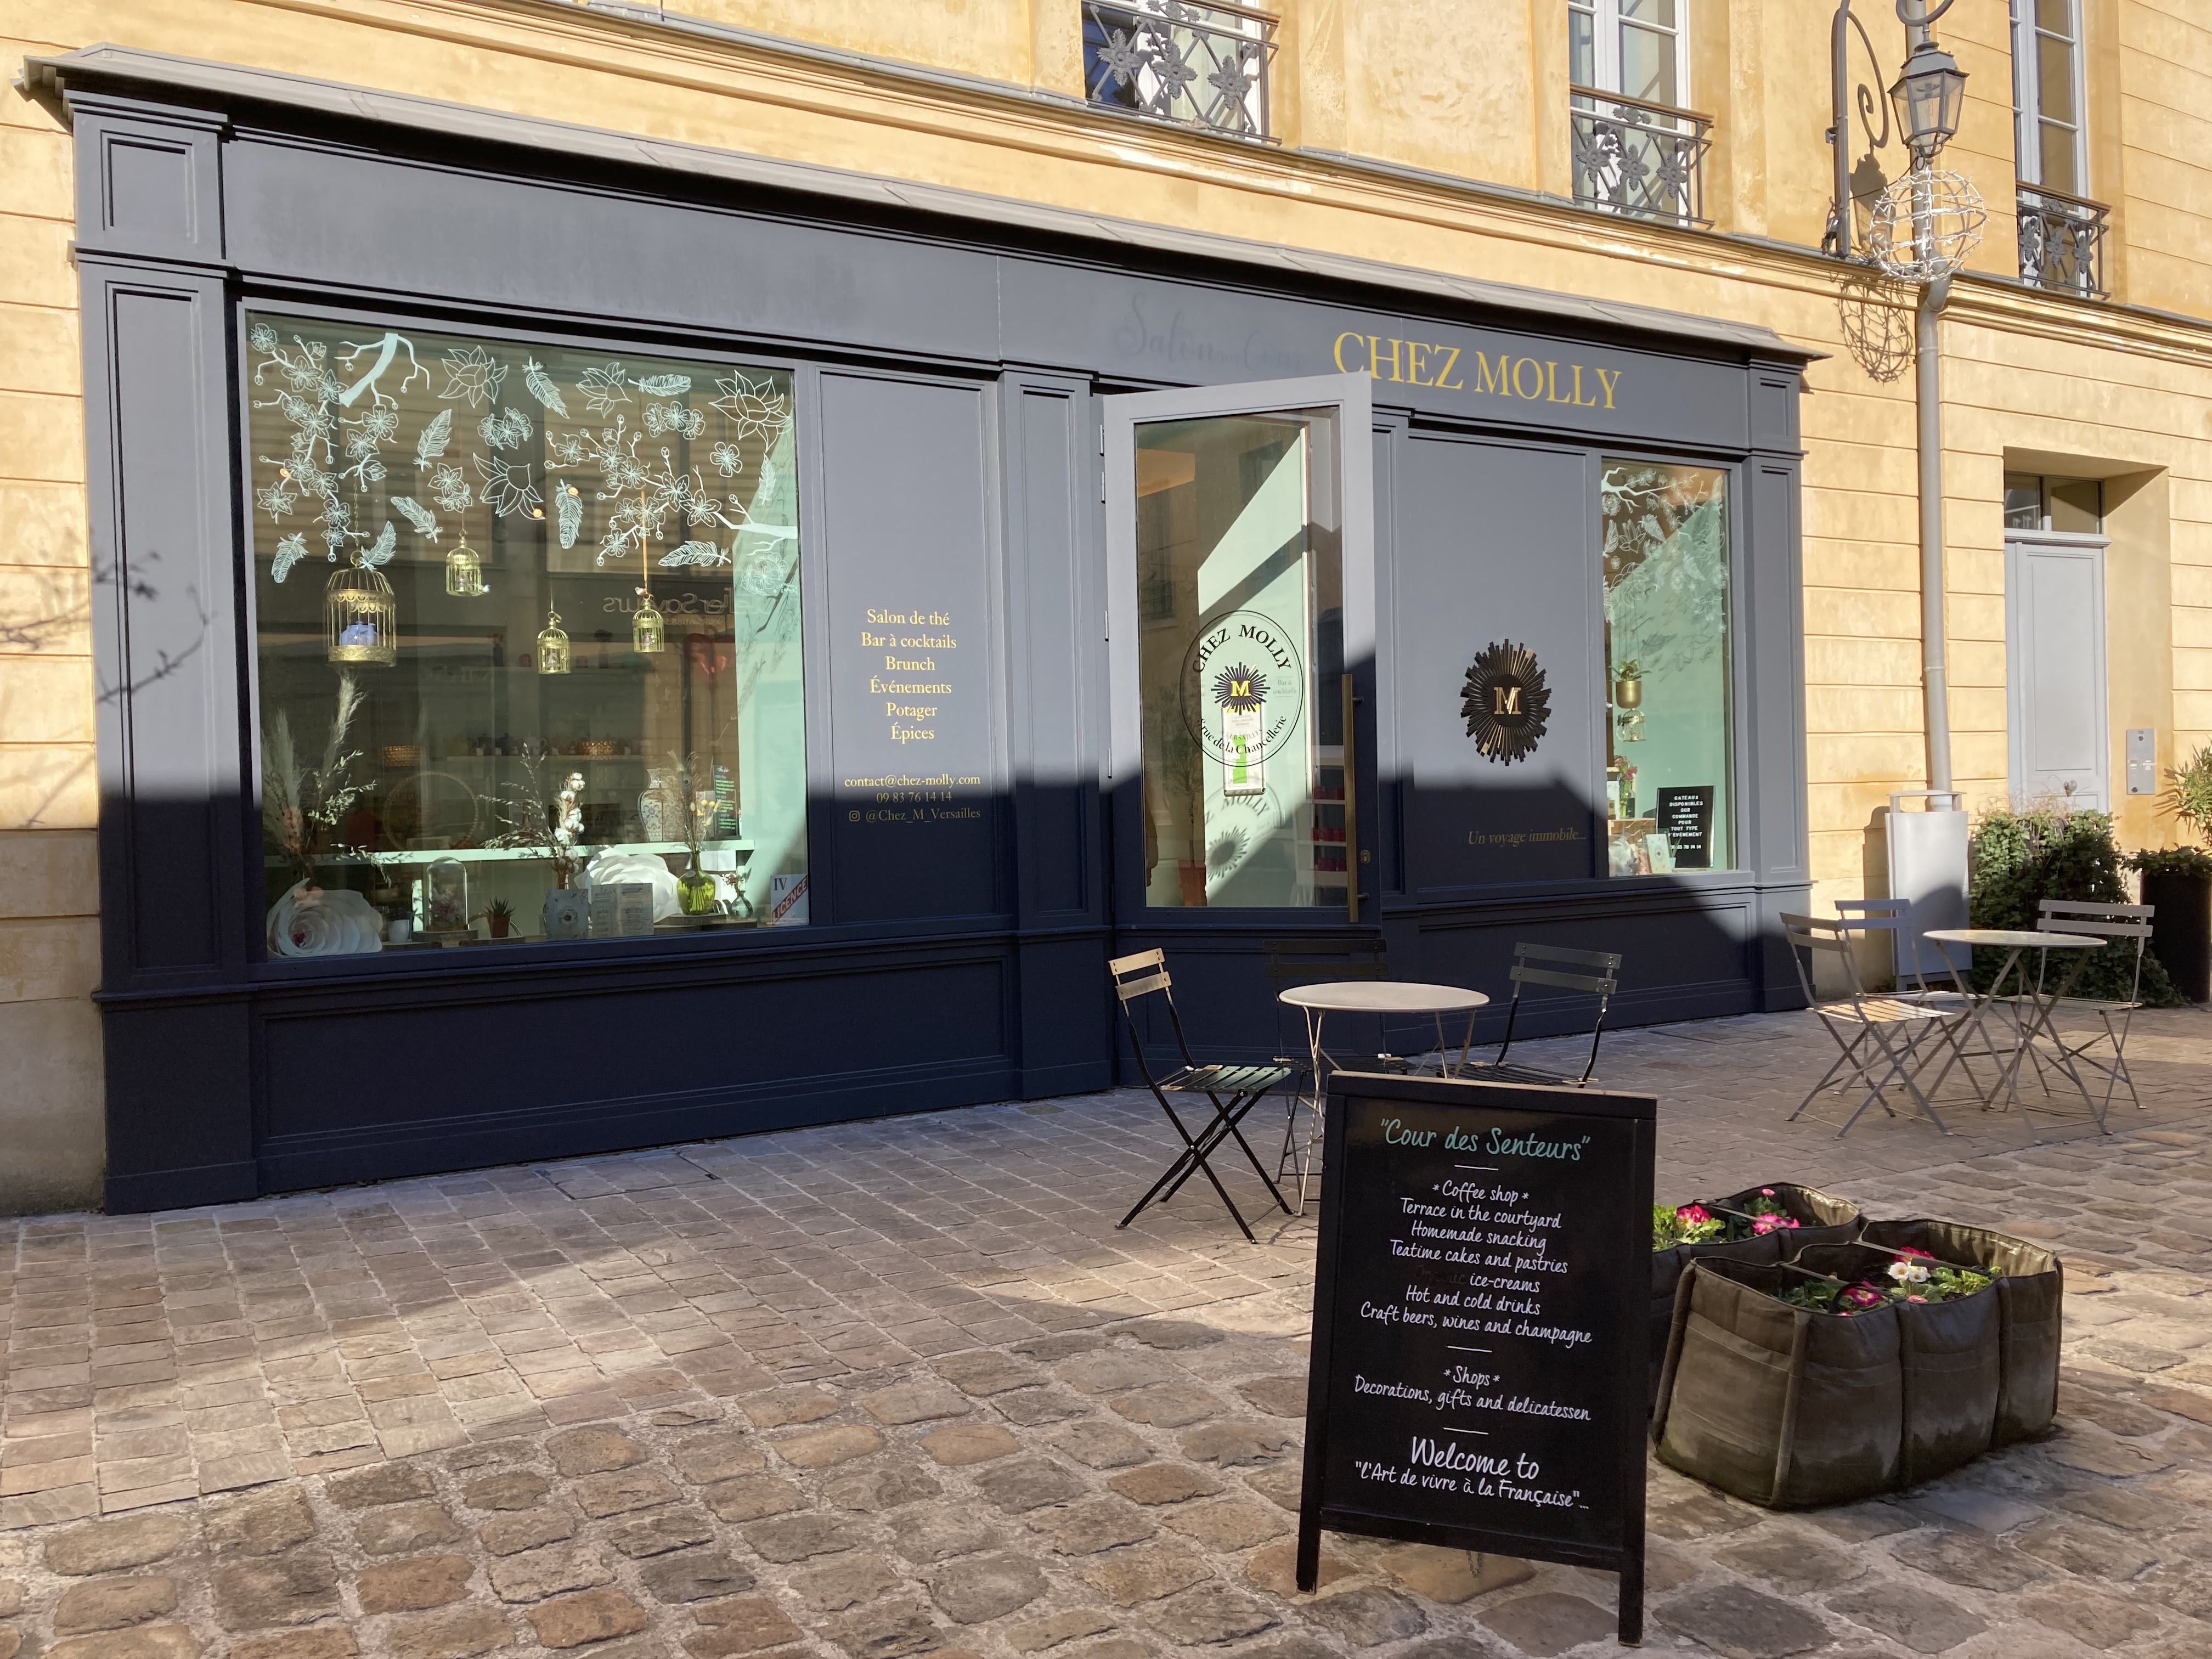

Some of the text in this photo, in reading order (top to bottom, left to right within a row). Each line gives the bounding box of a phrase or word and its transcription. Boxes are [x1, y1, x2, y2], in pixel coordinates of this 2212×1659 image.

[1334, 332, 1622, 409] CHEZ MOLLY
[867, 608, 950, 625] Salon de thé
[861, 631, 957, 648] Bar à cocktails
[1192, 624, 1291, 673] CHEZ MOLLY
[885, 656, 935, 670] Brunch
[870, 675, 952, 693] Événements
[1231, 680, 1251, 697] M
[886, 702, 938, 721] Potager
[1494, 686, 1522, 715] M
[890, 721, 935, 744] Épices
[1201, 725, 1214, 741] rue
[1213, 738, 1224, 749] de
[1225, 742, 1233, 754] la
[1236, 716, 1286, 754] Chancellerie
[844, 774, 981, 788] contact@chez-molly.com
[876, 791, 952, 803] 09 83 76 14 14
[866, 807, 981, 823] @Chez_M_Versailles
[1468, 827, 1587, 847] Un voyage immobile...
[774, 878, 787, 891] IV
[772, 878, 808, 923] LICENCE
[1381, 1119, 1590, 1161] "Cour des Senteurs"
[1442, 1180, 1519, 1203] Coffee shop
[1401, 1198, 1561, 1232] Terrace in the courtyard
[1411, 1220, 1547, 1256] Homemade snacking
[1390, 1239, 1568, 1273] Teatime cakes and pastries
[1470, 1273, 1541, 1293] ice-creams
[1406, 1285, 1541, 1315] Hot and cold drinks
[1361, 1301, 1592, 1348] Craft beers, wines and champagne
[1453, 1365, 1490, 1390] Shops
[1355, 1374, 1592, 1421] Decorations, gifts and delicatessen
[1411, 1436, 1539, 1480] Welcome to
[1355, 1461, 1396, 1483] "l'Art
[1400, 1468, 1418, 1486] de
[1422, 1474, 1457, 1492] vivre
[1463, 1479, 1474, 1494] à
[1479, 1478, 1495, 1497] la
